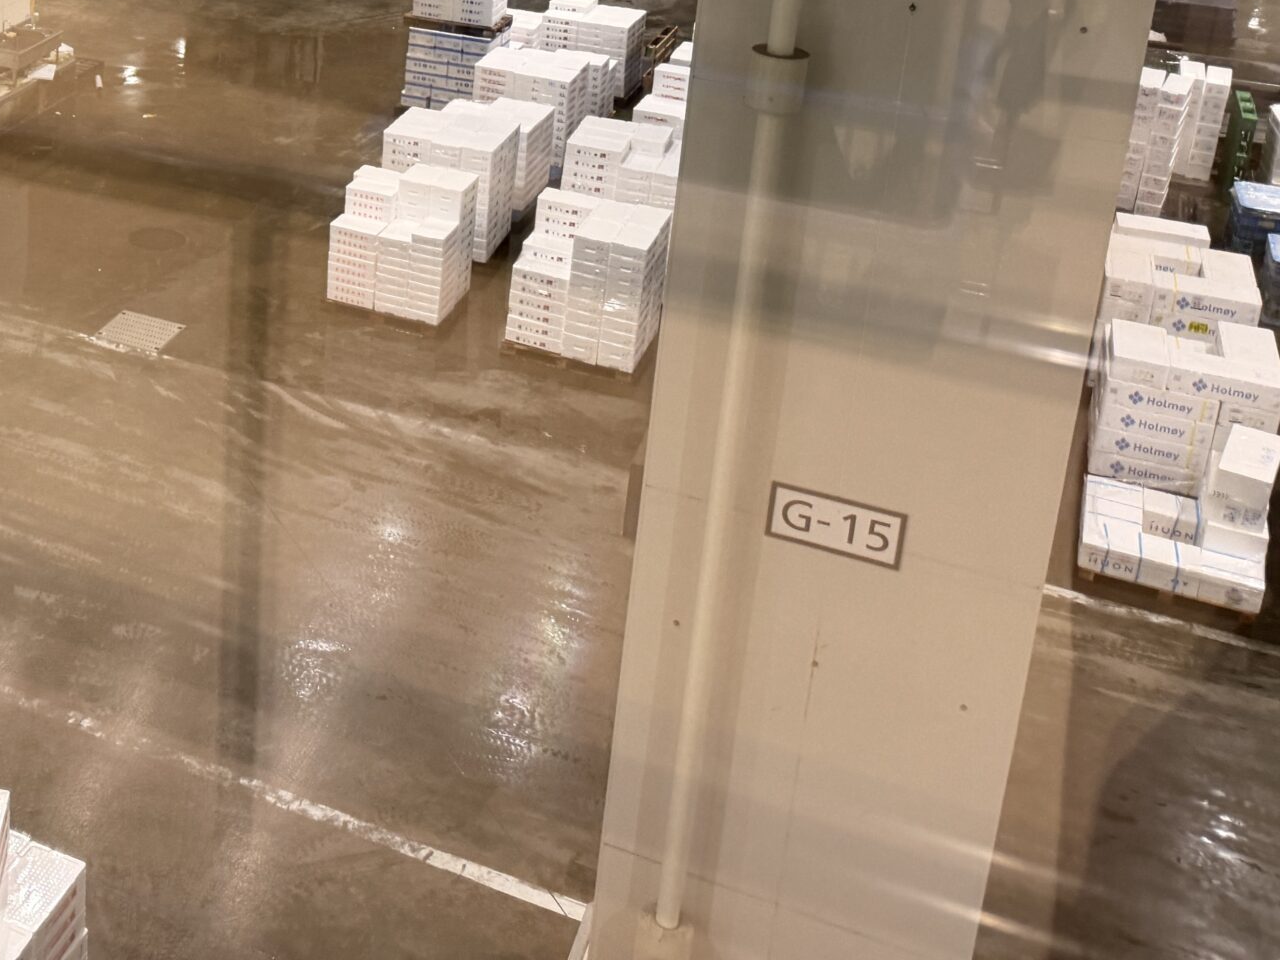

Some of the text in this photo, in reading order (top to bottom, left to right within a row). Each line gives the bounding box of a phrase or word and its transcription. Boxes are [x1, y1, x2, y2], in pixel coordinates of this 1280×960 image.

[1210, 383, 1260, 403] Holmøy
[1146, 396, 1193, 415] Holmøy
[1138, 419, 1186, 438] Holmøy
[1133, 443, 1180, 461] Holmøy
[781, 499, 892, 552] G-15
